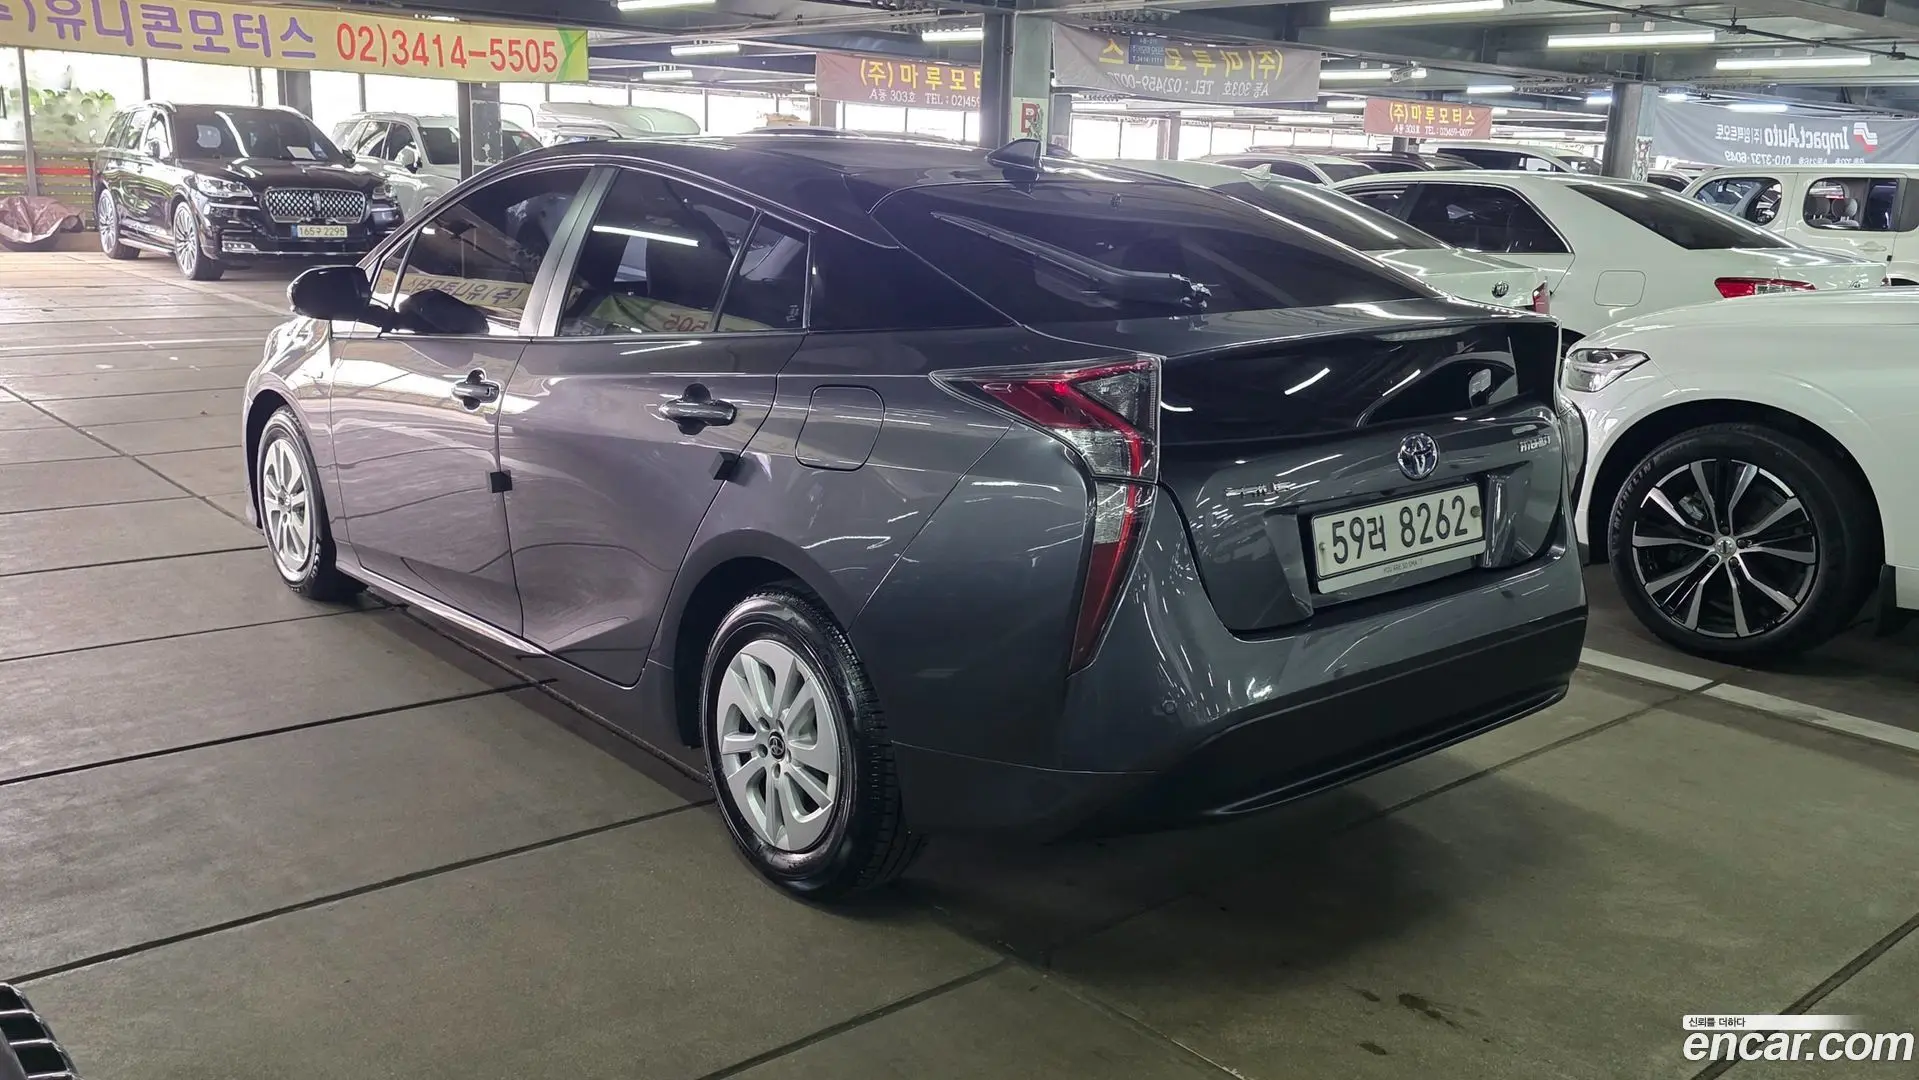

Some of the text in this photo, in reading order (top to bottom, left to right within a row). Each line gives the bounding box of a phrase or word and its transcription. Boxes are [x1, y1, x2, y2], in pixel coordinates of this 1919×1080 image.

[336, 23, 558, 74] 02)3414-5505
[890, 90, 916, 104] 303호
[1332, 494, 1468, 565] 59러 8262
